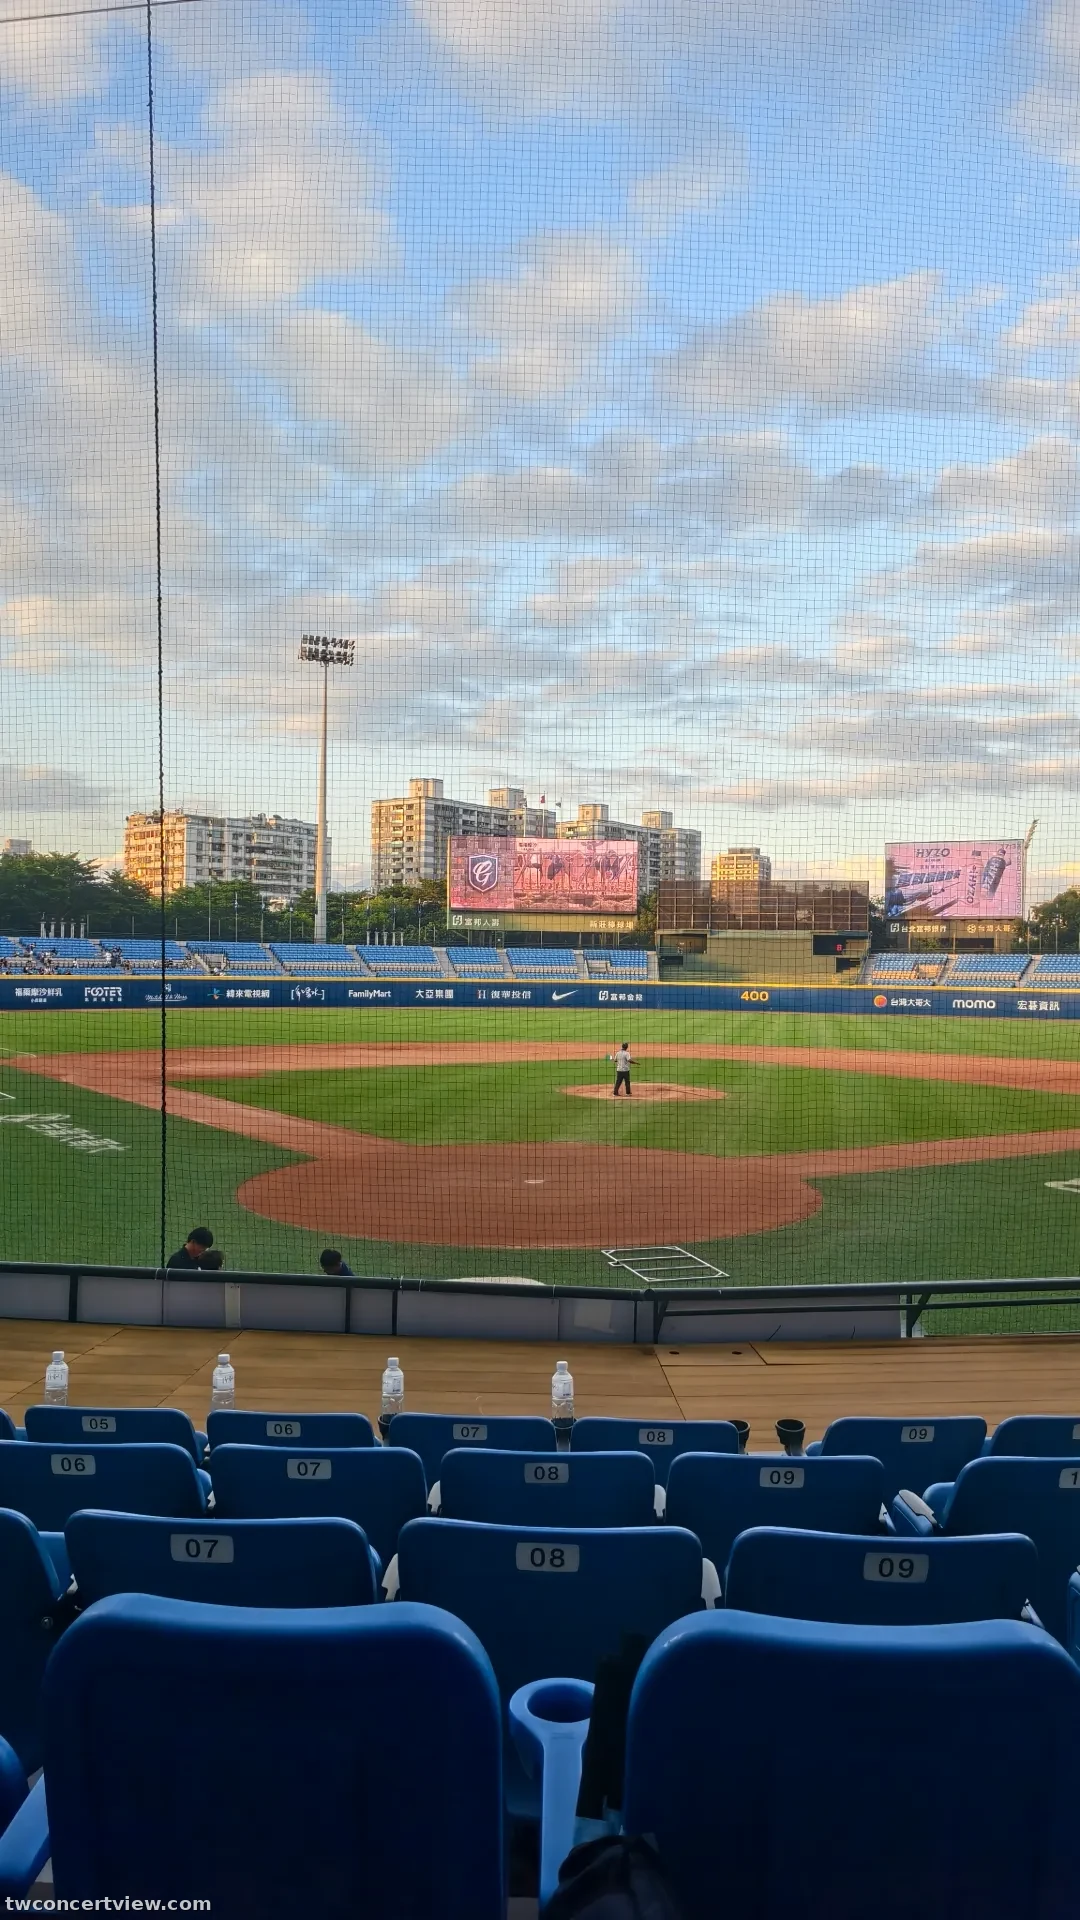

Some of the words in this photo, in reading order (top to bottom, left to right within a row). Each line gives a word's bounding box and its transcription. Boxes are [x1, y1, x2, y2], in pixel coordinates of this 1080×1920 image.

[916, 848, 950, 857] HYZO
[84, 987, 122, 997] FOOTER
[226, 989, 270, 998] 緯來電視網
[348, 989, 391, 999] FamilyMart
[415, 989, 454, 999] 大亞集團
[490, 989, 532, 999] 復華投信
[740, 991, 769, 1001] 400
[890, 998, 932, 1007] 台灣大哥大
[952, 998, 996, 1009] momo
[1017, 1000, 1060, 1011] 宏碁資訊
[89, 1418, 109, 1430] 05
[274, 1423, 293, 1435] 06
[460, 1426, 480, 1438] 07
[646, 1431, 666, 1443] 08
[909, 1428, 928, 1440] 09
[60, 1457, 86, 1472] 06
[296, 1461, 321, 1477] 07
[533, 1466, 559, 1481] 08
[769, 1470, 795, 1485] 09
[185, 1538, 219, 1559] 07
[530, 1547, 565, 1568] 08
[878, 1557, 915, 1579] 09
